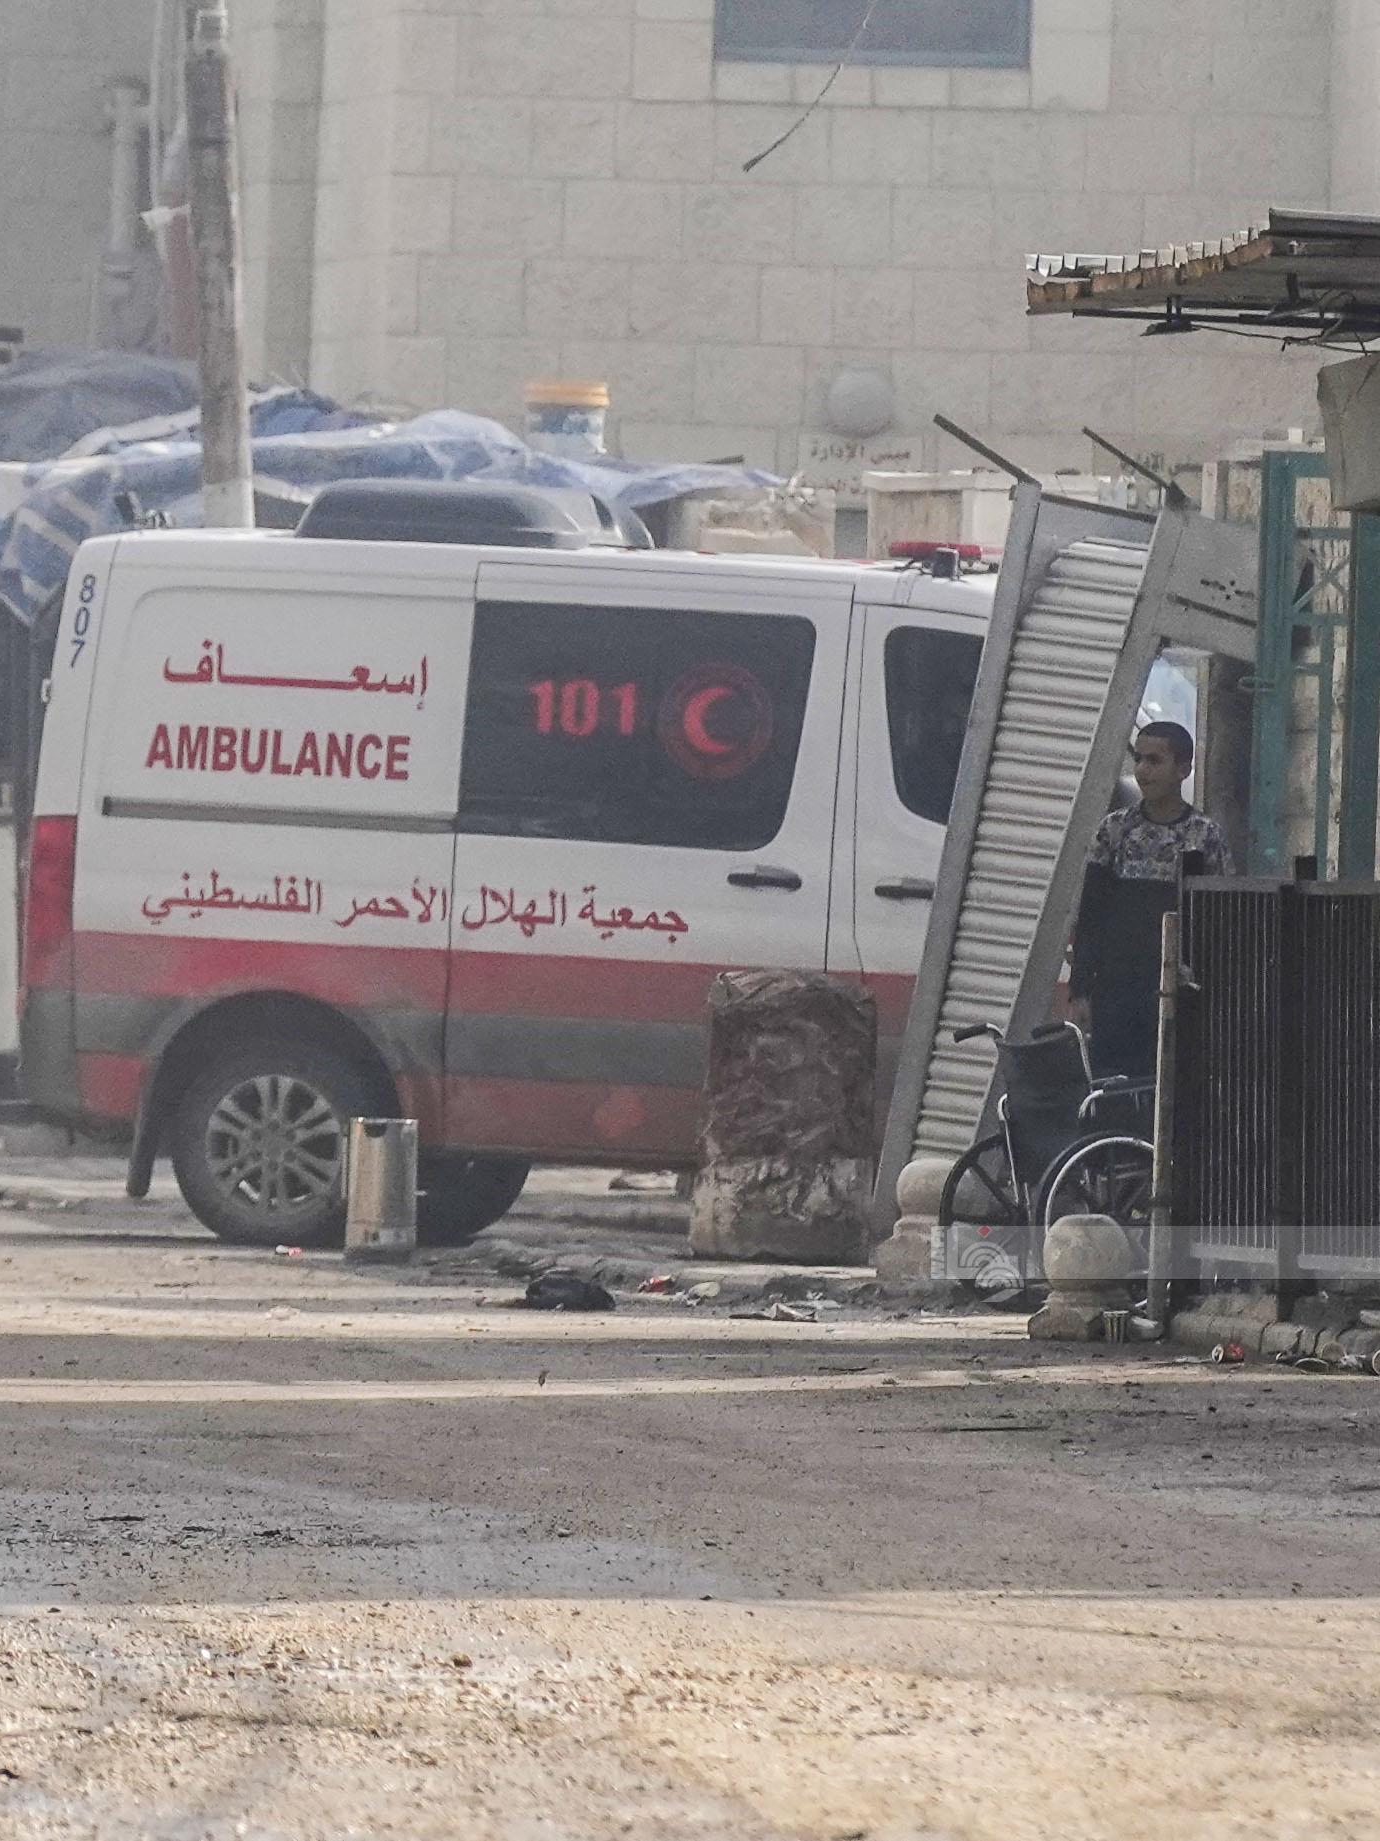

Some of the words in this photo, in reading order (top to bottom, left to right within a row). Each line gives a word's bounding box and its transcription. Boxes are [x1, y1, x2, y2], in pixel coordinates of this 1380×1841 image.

[71, 573, 96, 668] 807
[163, 639, 427, 710] إسعاف
[524, 680, 638, 736] 101
[144, 723, 412, 780] AMBULANCE
[141, 868, 321, 926] الفلسطيني
[332, 877, 447, 928] الأحمر
[461, 884, 566, 937] الهلال
[578, 884, 689, 944] جمعية
